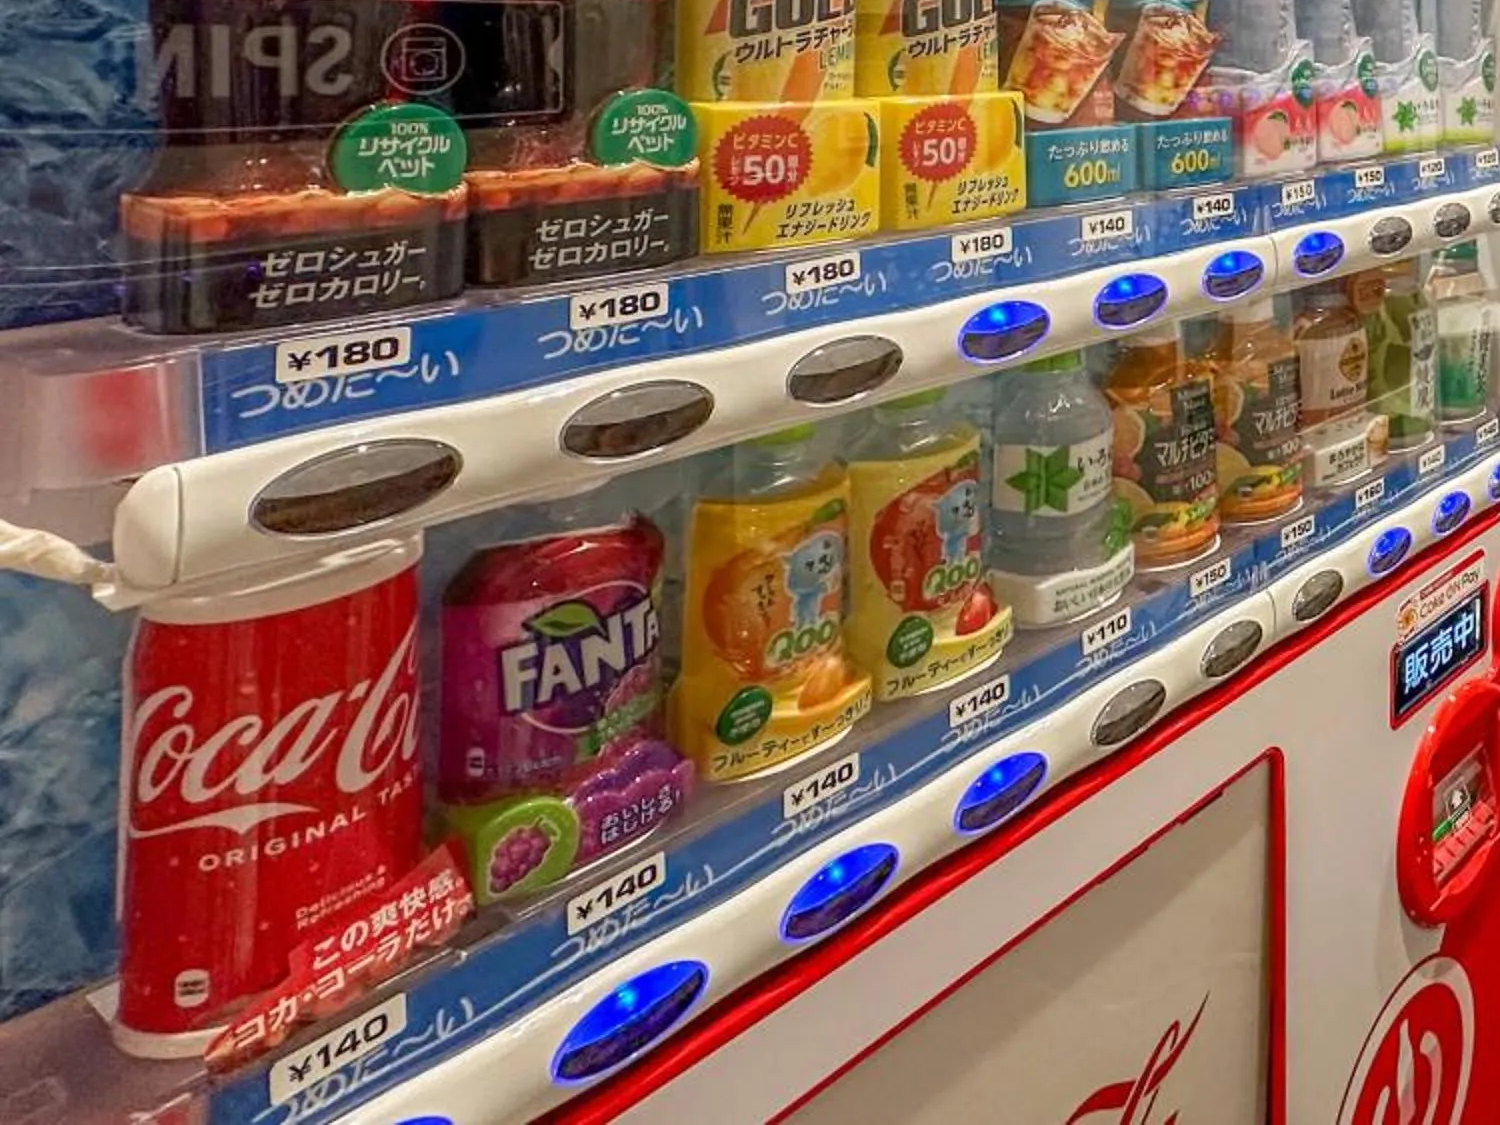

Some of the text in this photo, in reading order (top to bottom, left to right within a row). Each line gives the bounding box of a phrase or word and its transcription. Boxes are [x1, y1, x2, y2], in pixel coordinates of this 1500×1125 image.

[635, 102, 669, 117] 100%
[390, 121, 430, 136] 100%
[611, 115, 687, 136] リサイクル
[915, 117, 968, 136] ビタミンC
[357, 136, 451, 157] リサイクル
[627, 133, 675, 154] ペット
[733, 132, 800, 151] ビタミンC
[922, 136, 956, 167] 50
[1048, 136, 1129, 163] たっぷり飲める
[1156, 128, 1229, 156] たっぷり飲める
[377, 157, 436, 179] ペット
[742, 153, 786, 187] 50
[1063, 159, 1122, 190] 600ml
[1170, 146, 1221, 175] 600ml
[785, 197, 856, 220] リフレッシュ
[1196, 197, 1231, 214] ¥140
[536, 209, 670, 245] ゼロシュガー
[775, 211, 872, 239] エナジードリンク
[1088, 217, 1126, 234] ¥140
[959, 233, 1005, 254] ¥180
[260, 243, 427, 280] ゼロシュガー
[791, 259, 856, 286] ¥180
[578, 291, 661, 320] ¥180
[287, 337, 400, 371] ¥180
[1193, 565, 1228, 588] ¥150
[1086, 615, 1128, 646] ¥110
[502, 594, 660, 712] FANTA
[1404, 612, 1475, 695] 販売中
[955, 681, 1006, 718] ¥140
[790, 762, 854, 806] ¥140
[198, 806, 368, 873] ORIGINAL
[576, 863, 658, 922] ¥140
[313, 868, 465, 970] この爽快感。
[231, 891, 475, 1049] コカ・コーラだけ。
[287, 1013, 389, 1083] ¥140
